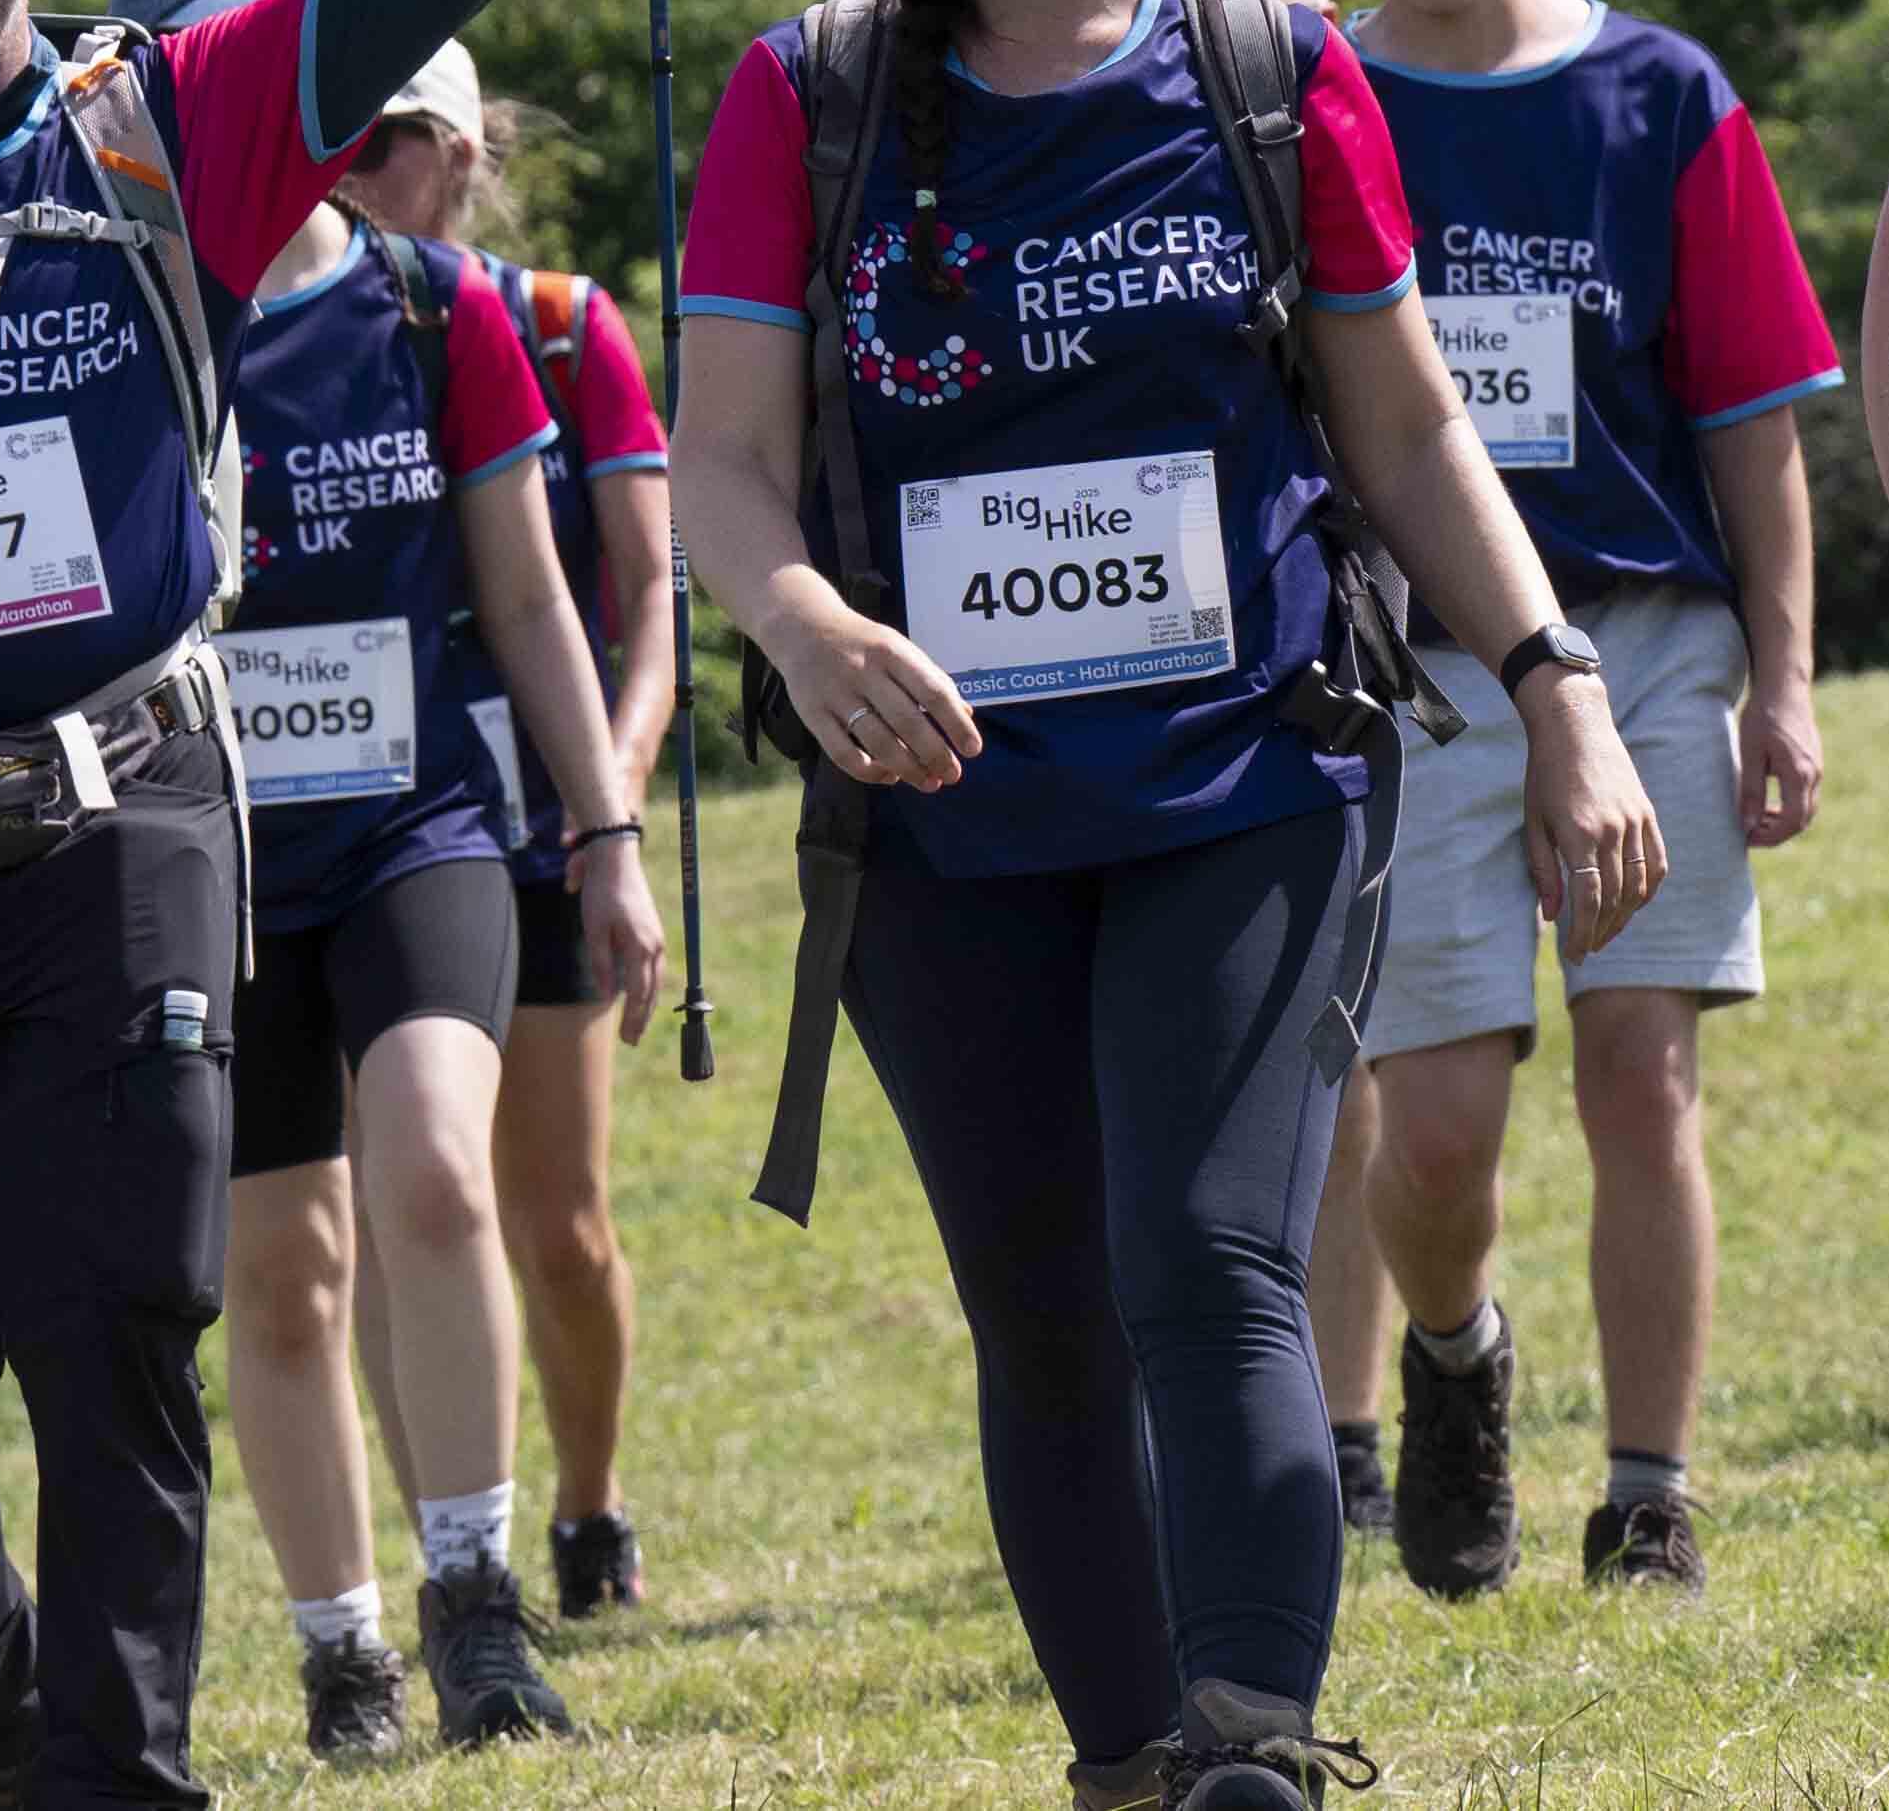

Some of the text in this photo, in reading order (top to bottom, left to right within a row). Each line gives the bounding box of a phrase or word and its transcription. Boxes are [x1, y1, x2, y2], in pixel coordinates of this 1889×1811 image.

[1015, 215, 1226, 274] CANCER
[1443, 224, 1595, 272] CANCER
[1017, 250, 1260, 322] RESEARCH
[1021, 326, 1096, 372] UK
[1443, 323, 1508, 352] Hike
[286, 428, 429, 477] CANCER
[297, 517, 352, 553] UK
[982, 492, 1133, 541] Big Hike
[961, 553, 1169, 620] 40083
[235, 649, 350, 686] Big Hike
[1010, 669, 1065, 689] Coast
[1079, 660, 1121, 681] Half
[1124, 650, 1216, 675] marathon
